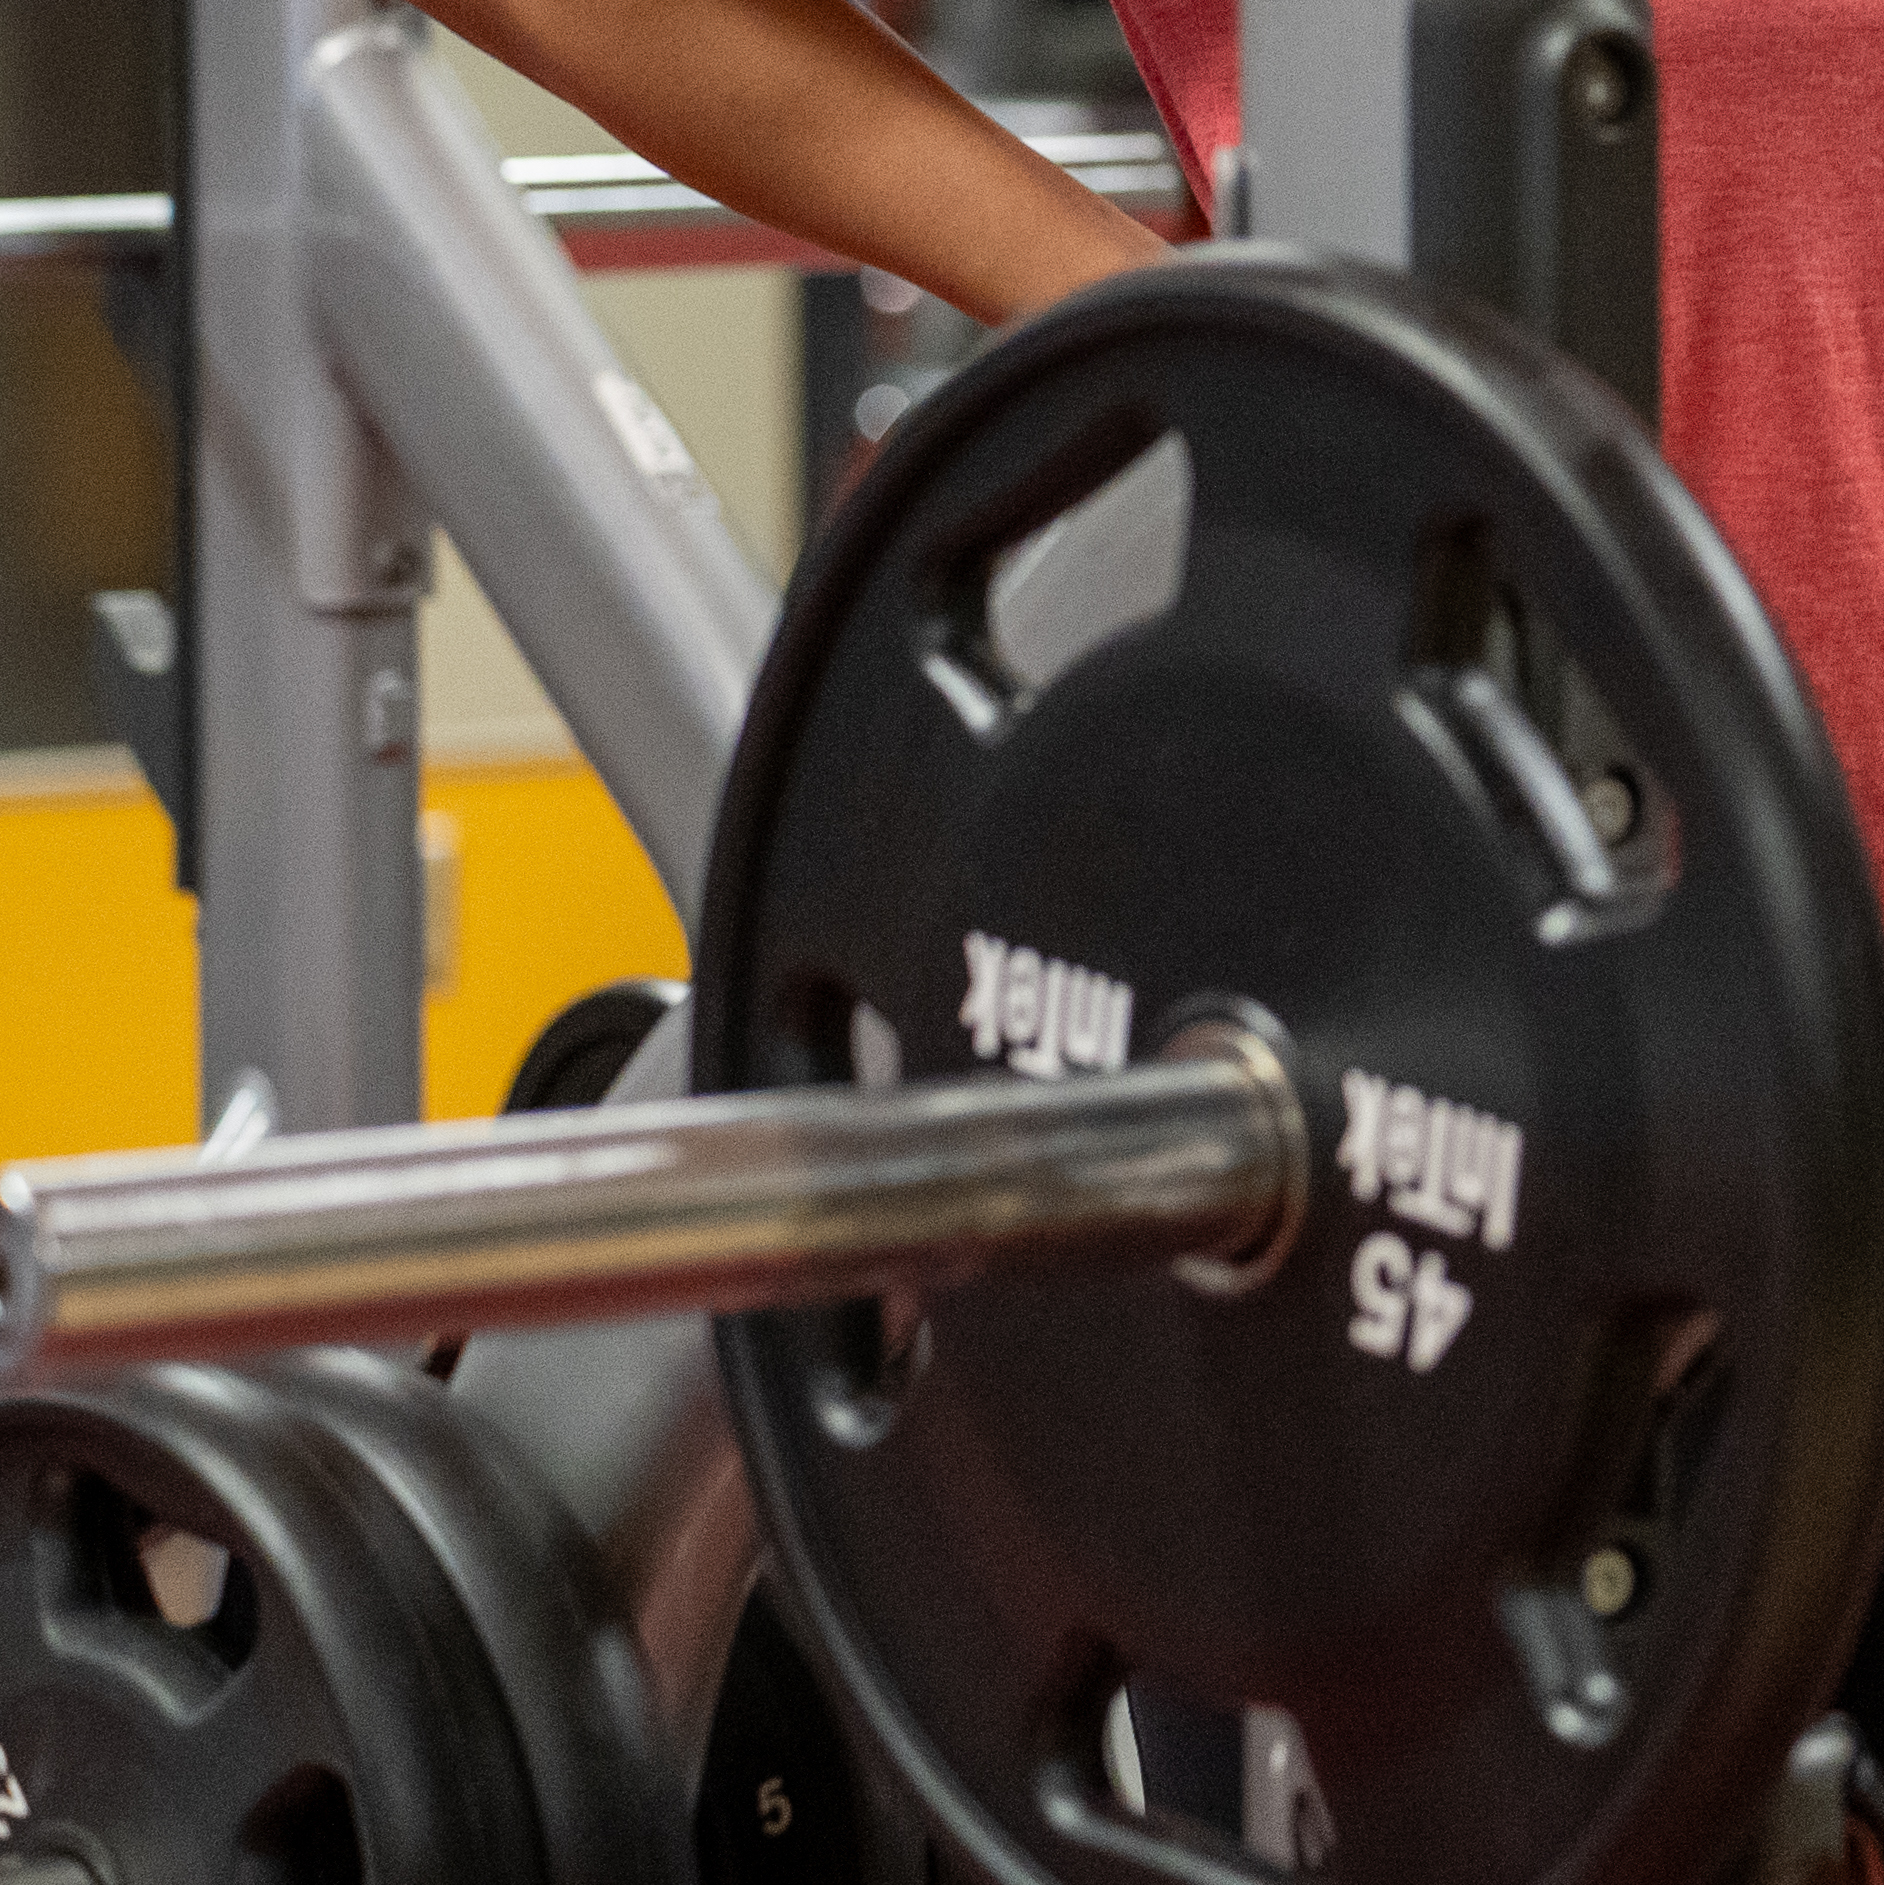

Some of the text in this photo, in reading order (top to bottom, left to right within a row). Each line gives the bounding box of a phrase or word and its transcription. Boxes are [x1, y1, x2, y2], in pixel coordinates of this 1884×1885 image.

[960, 928, 1133, 1079] InTek
[1336, 1068, 1524, 1252] InTek
[1348, 1231, 1473, 1375] 45
[757, 1776, 792, 1836] 5
